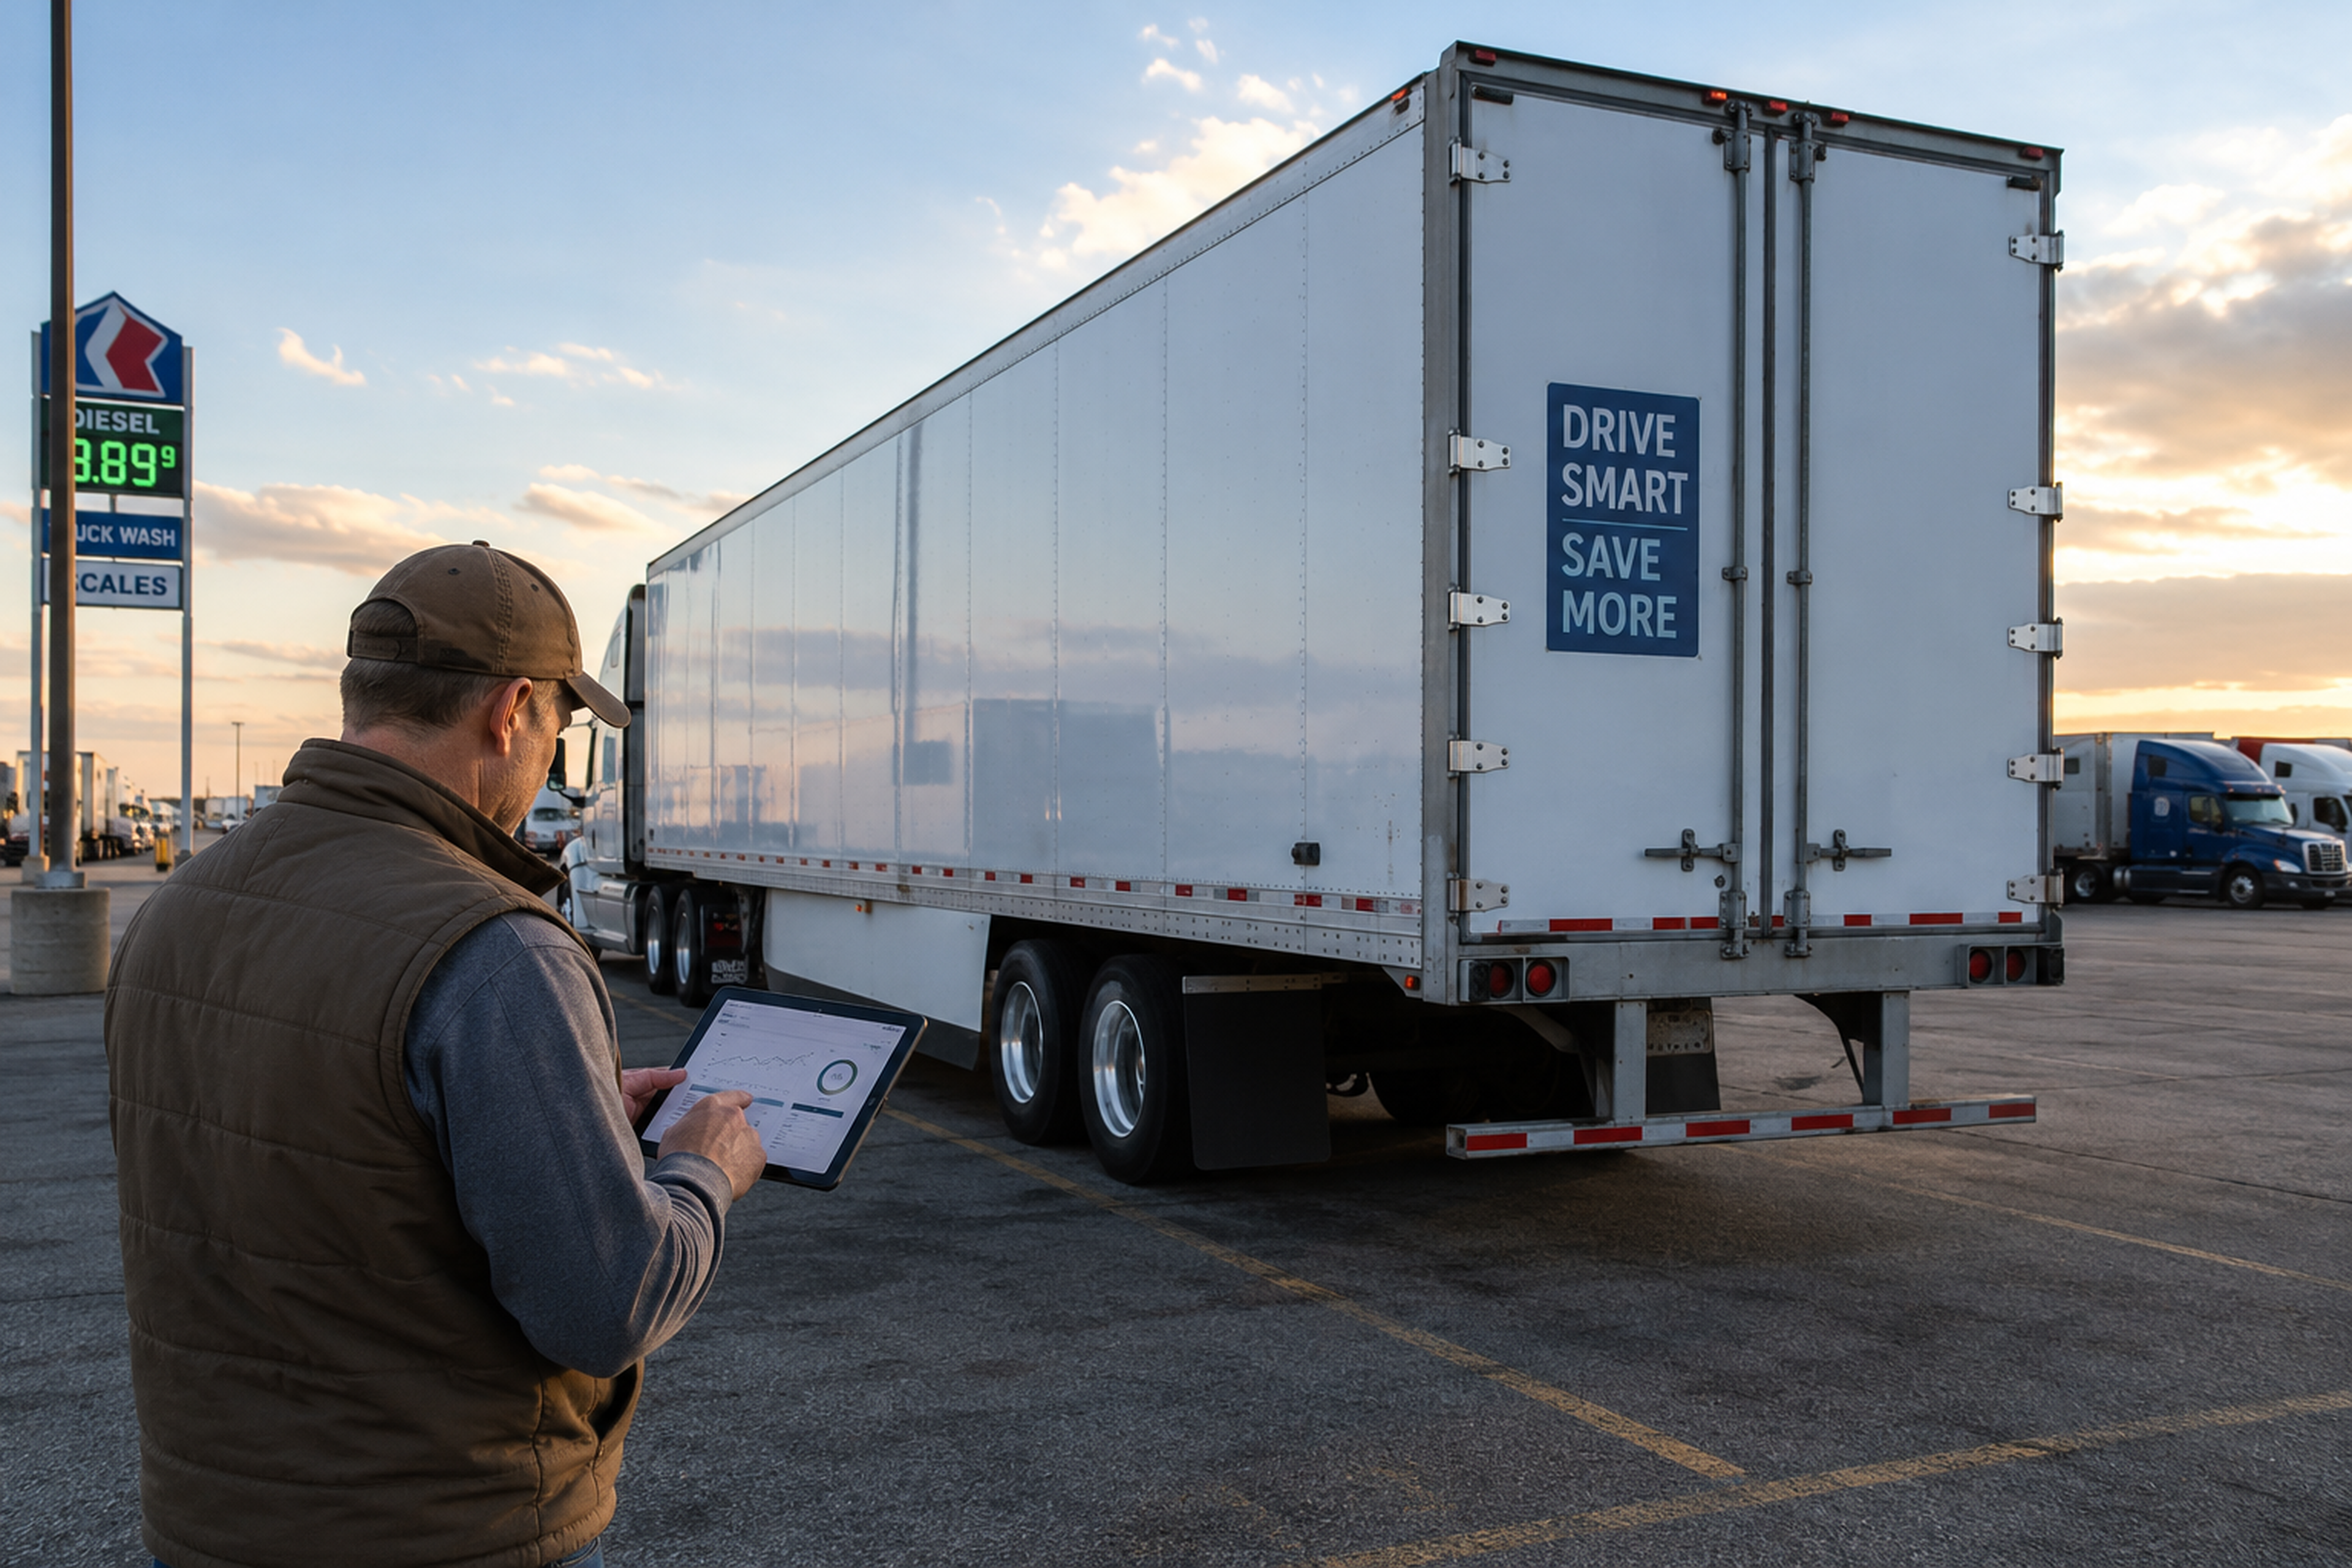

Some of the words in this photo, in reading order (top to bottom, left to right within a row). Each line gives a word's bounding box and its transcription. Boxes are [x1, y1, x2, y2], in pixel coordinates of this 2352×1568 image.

[75, 408, 160, 434] DIESEL
[1563, 404, 1675, 458] DRIVE
[1561, 462, 1688, 514] SMART
[75, 524, 113, 543] UCK
[119, 526, 175, 547] WASH
[1561, 532, 1660, 581] SAVE
[75, 573, 167, 596] CALES
[1562, 590, 1677, 638] MORE
